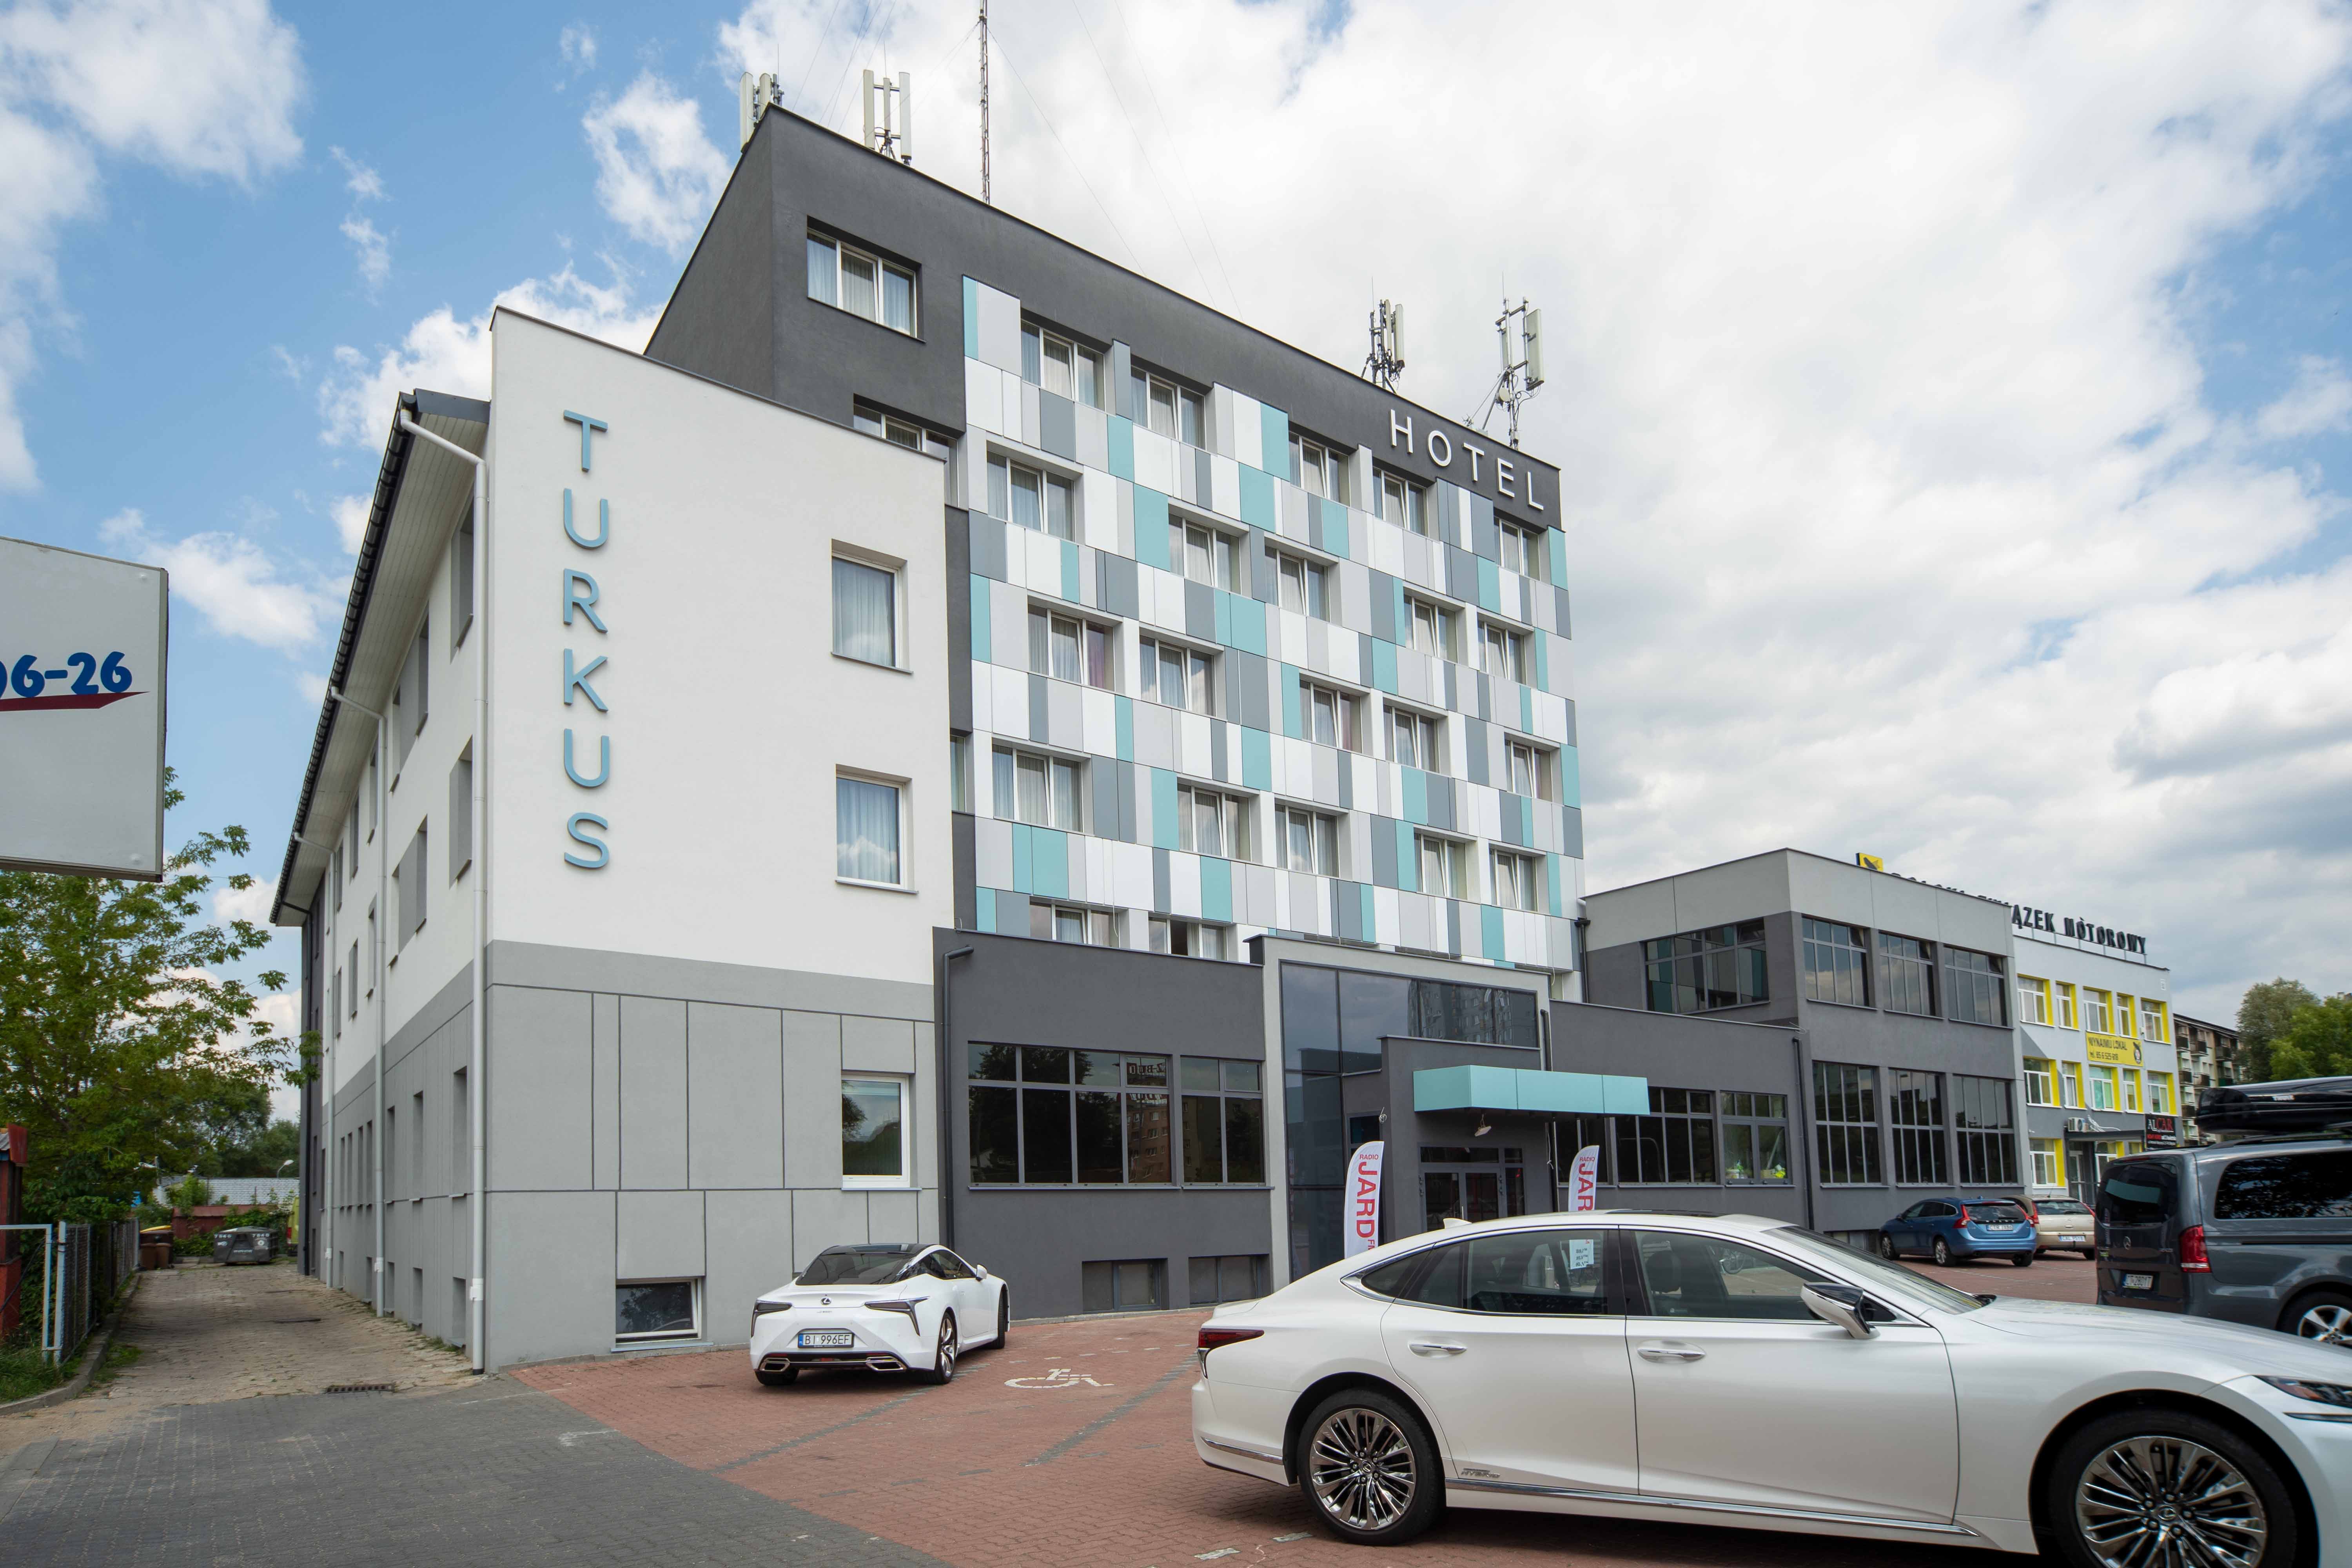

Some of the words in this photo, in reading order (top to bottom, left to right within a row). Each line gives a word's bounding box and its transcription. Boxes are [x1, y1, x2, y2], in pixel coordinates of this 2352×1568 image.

[1390, 409, 1544, 511] HOTEL
[563, 409, 610, 869] TURKUS
[1356, 1161, 1377, 1238] JARD
[1578, 1163, 1593, 1211] JAR
[805, 1335, 815, 1345] BI
[821, 1334, 850, 1345] 996EF
